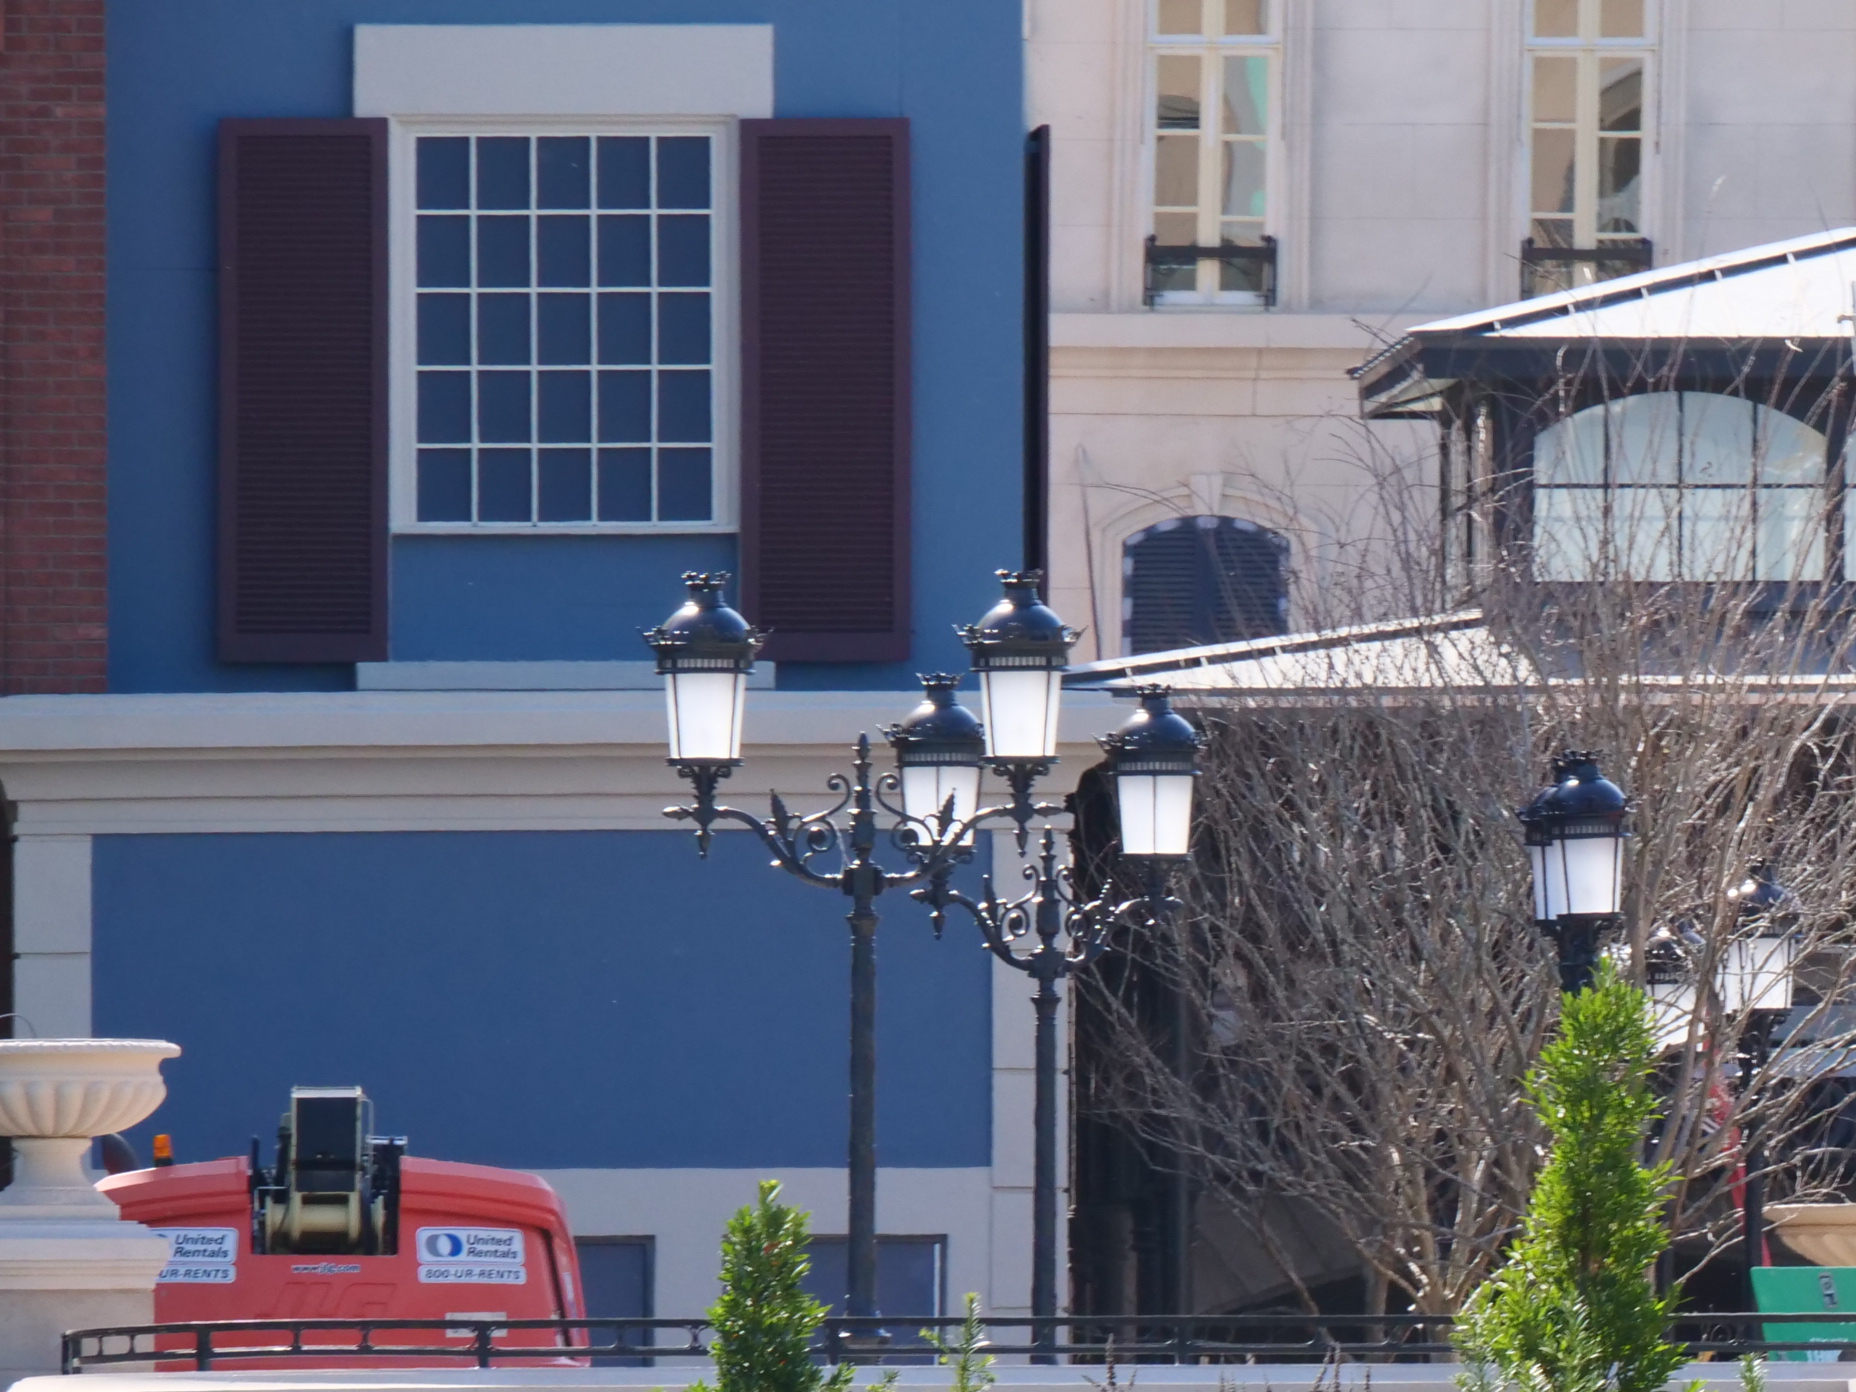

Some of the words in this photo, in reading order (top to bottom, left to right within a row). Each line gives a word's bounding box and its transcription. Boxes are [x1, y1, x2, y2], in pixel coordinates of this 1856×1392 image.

[175, 1234, 227, 1245] United
[466, 1234, 514, 1246] United
[174, 1247, 229, 1258] Rentals
[466, 1247, 518, 1259] Rentals
[159, 1269, 230, 1280] UR-RENTS
[425, 1269, 521, 1280] 800-UR-RENTS
